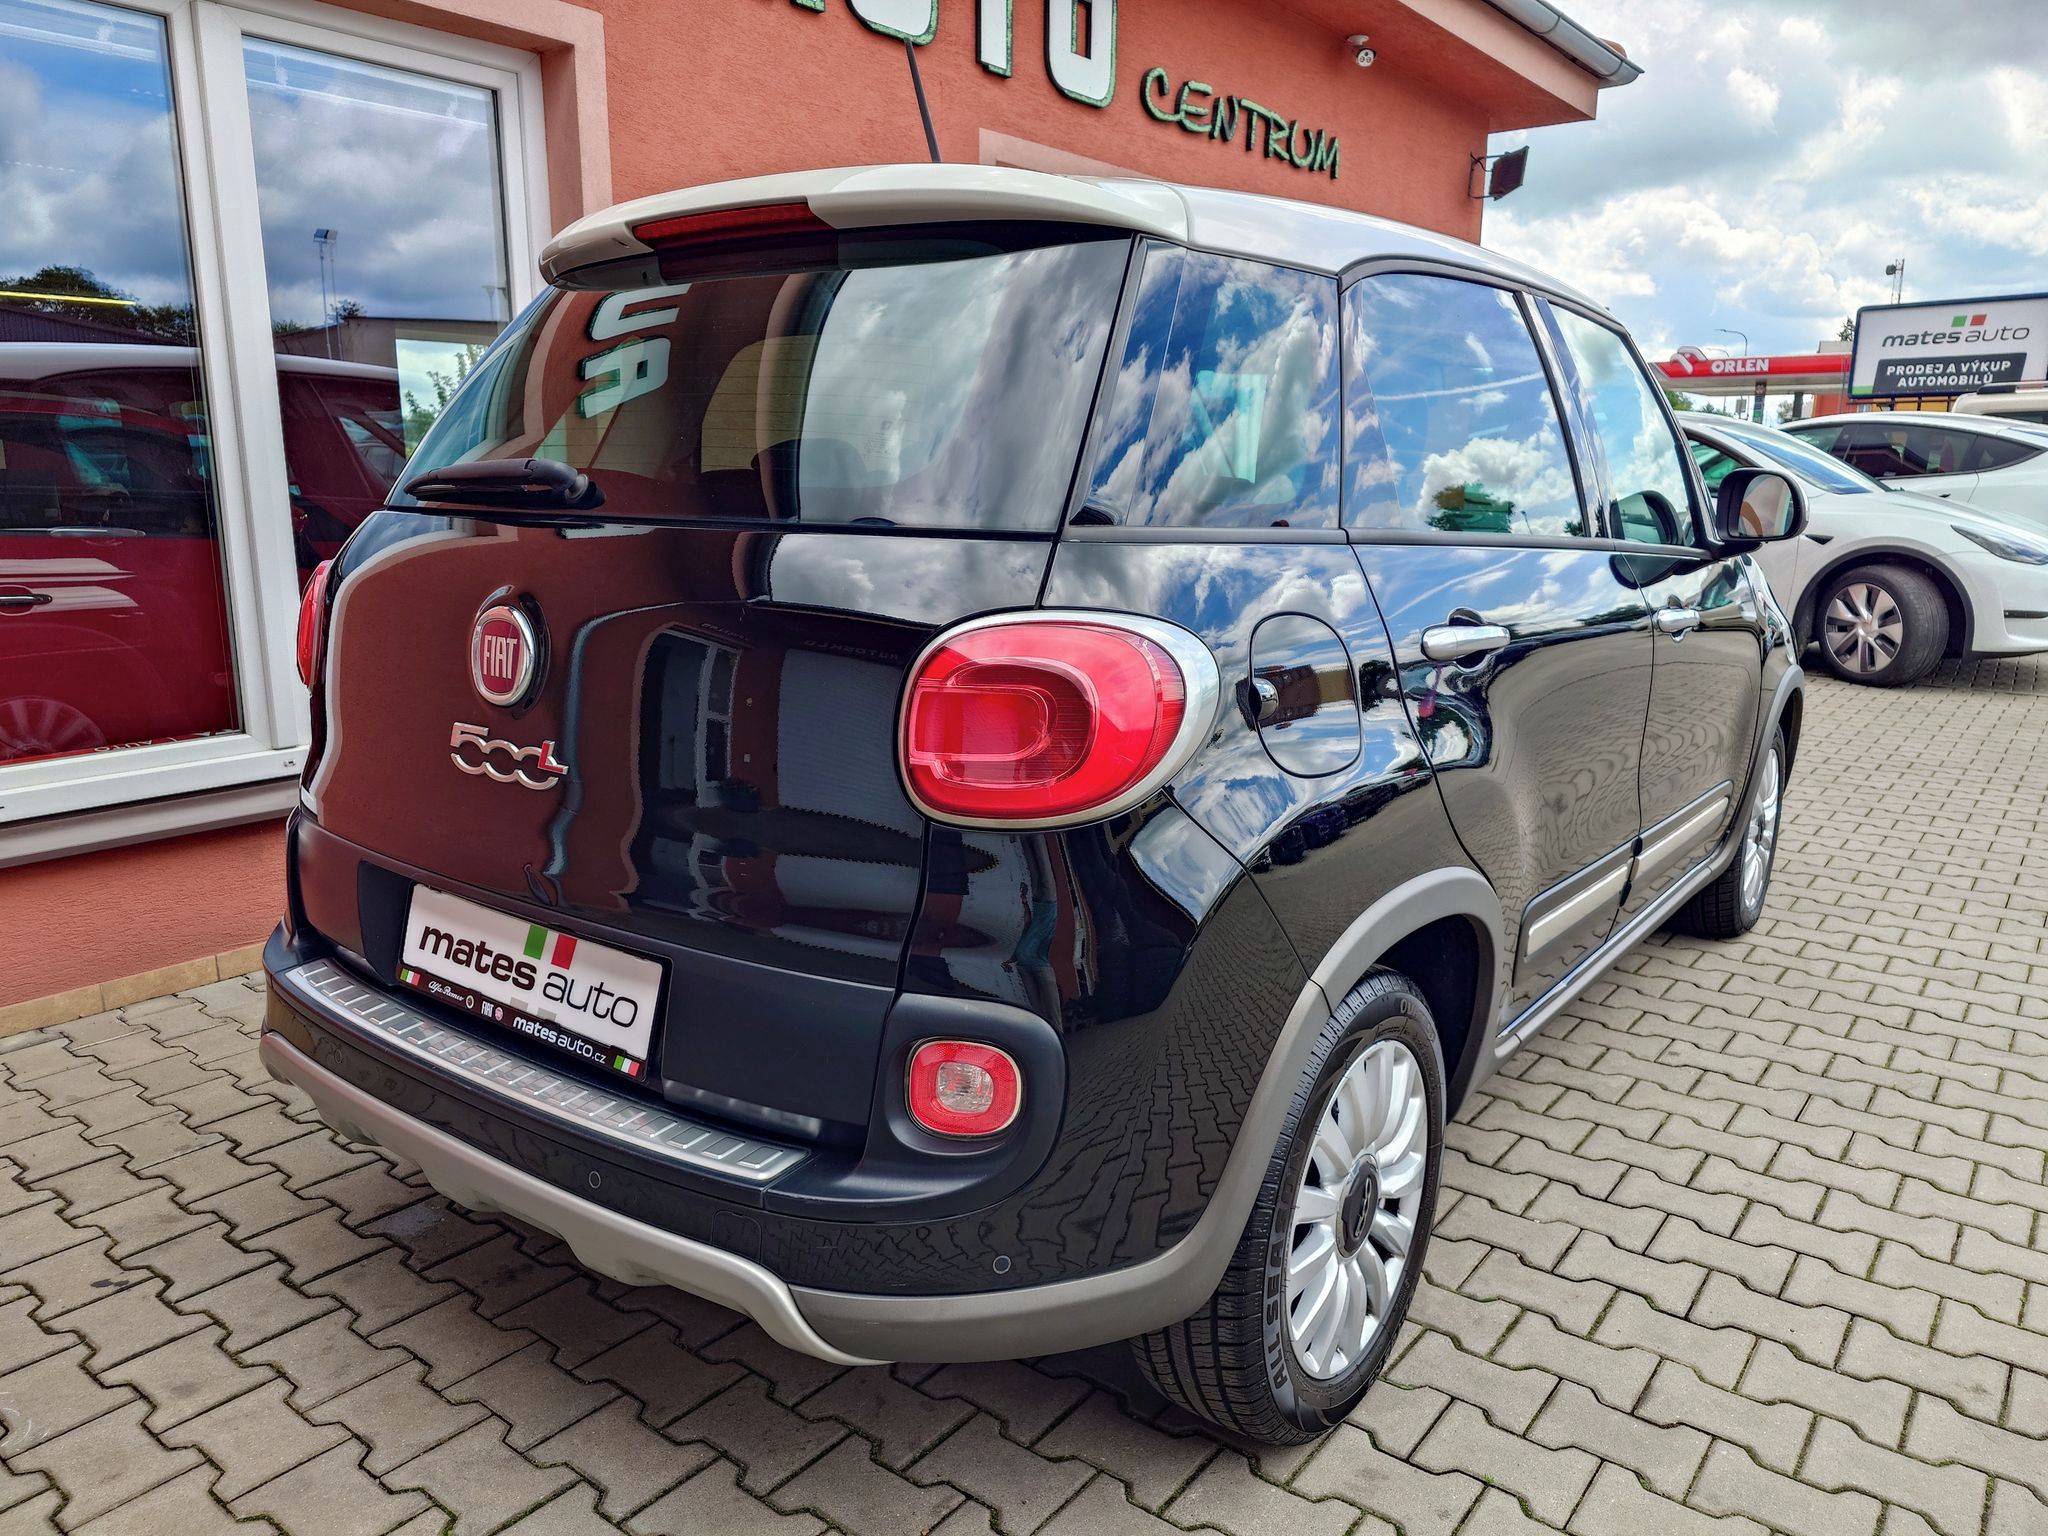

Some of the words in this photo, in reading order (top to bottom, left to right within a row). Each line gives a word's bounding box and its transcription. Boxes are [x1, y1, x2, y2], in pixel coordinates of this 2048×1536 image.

[1140, 66, 1340, 180] CENTRUM
[1882, 330, 1962, 348] mates
[1965, 325, 2030, 343] auto
[1711, 358, 1769, 374] ORLEN
[1886, 363, 1945, 376] PRODEJ
[1946, 363, 1956, 374] A
[1961, 360, 2011, 374] VÝKUP
[483, 635, 518, 680] FIAT
[450, 722, 569, 791] 500L
[418, 925, 537, 991] mates
[542, 971, 639, 1028] auto
[428, 981, 442, 994] Alfa
[442, 985, 465, 1002] Romeo
[481, 1000, 494, 1018] FIAT
[512, 1015, 607, 1065] matesauto.cz
[1267, 1331, 1288, 1390] ALL
